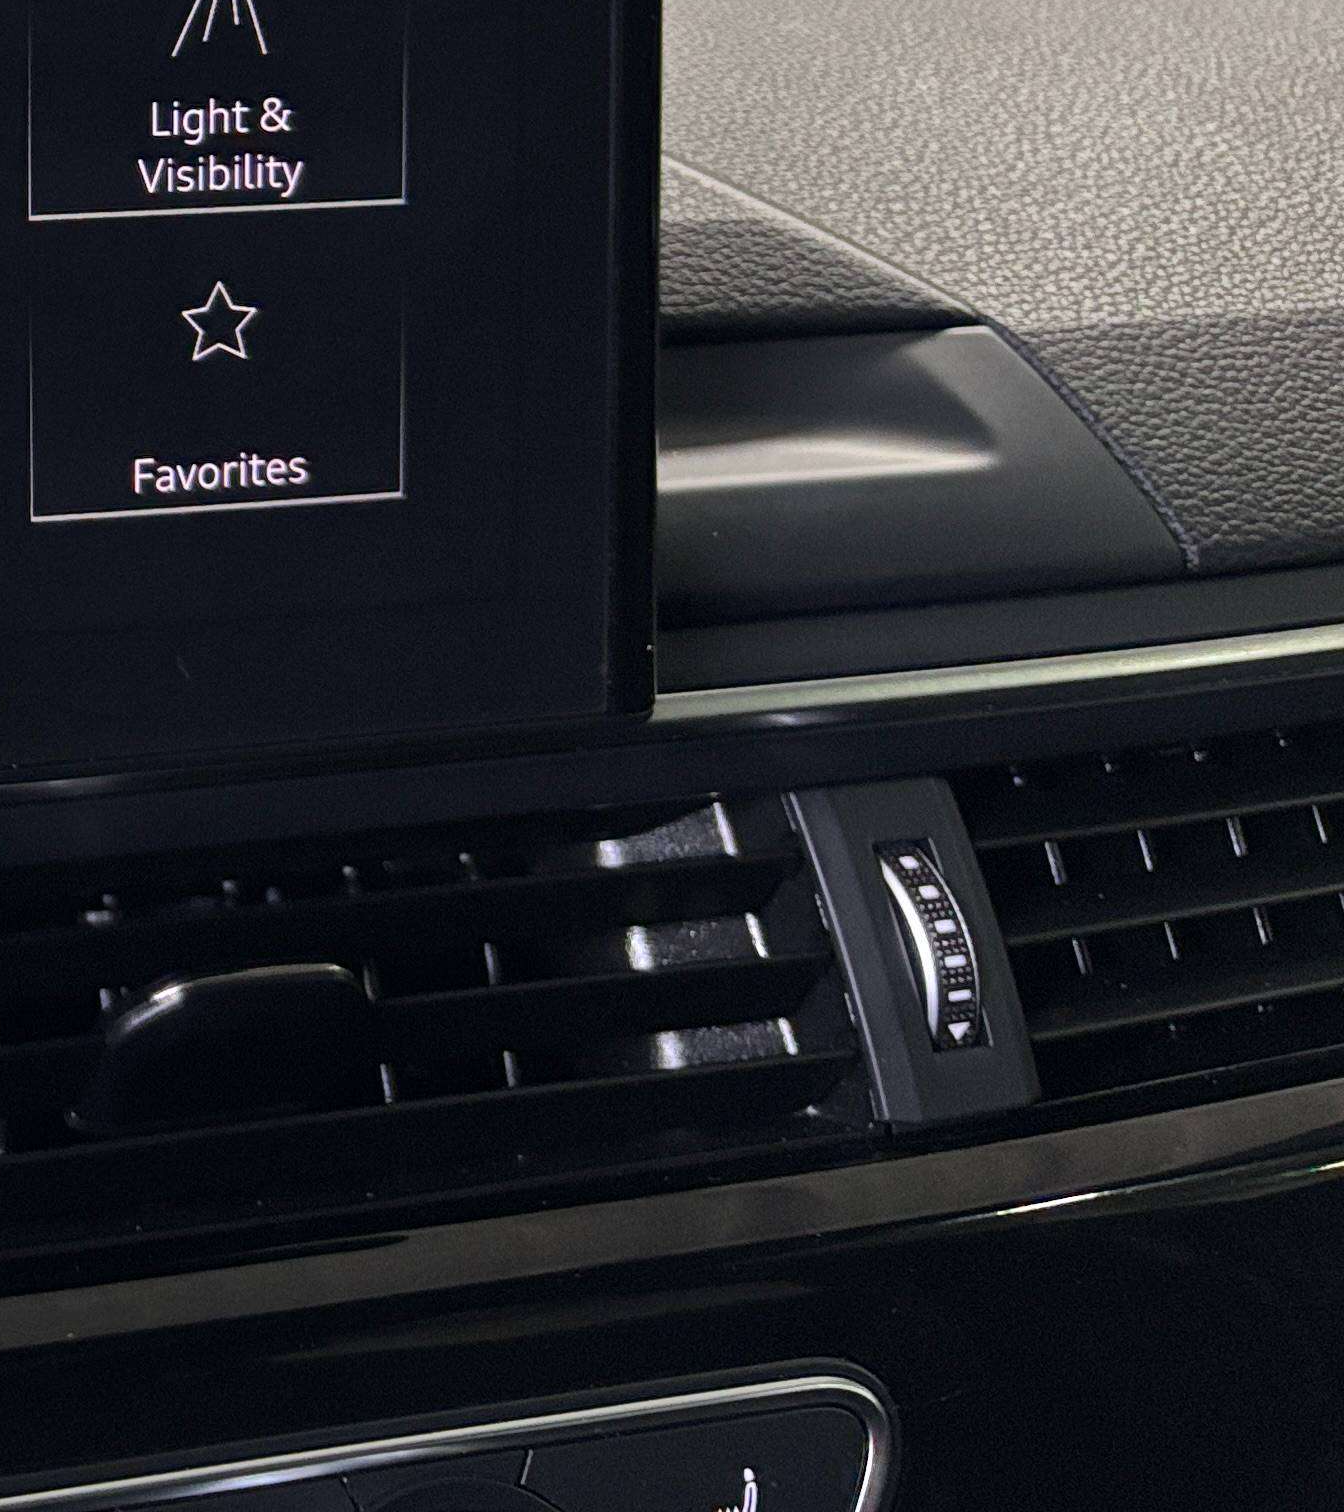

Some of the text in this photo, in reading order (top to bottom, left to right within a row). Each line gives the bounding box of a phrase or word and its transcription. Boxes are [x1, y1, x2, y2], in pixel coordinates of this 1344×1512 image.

[150, 96, 294, 146] Light &
[136, 153, 305, 198] Visibility
[132, 451, 310, 495] Favorites
